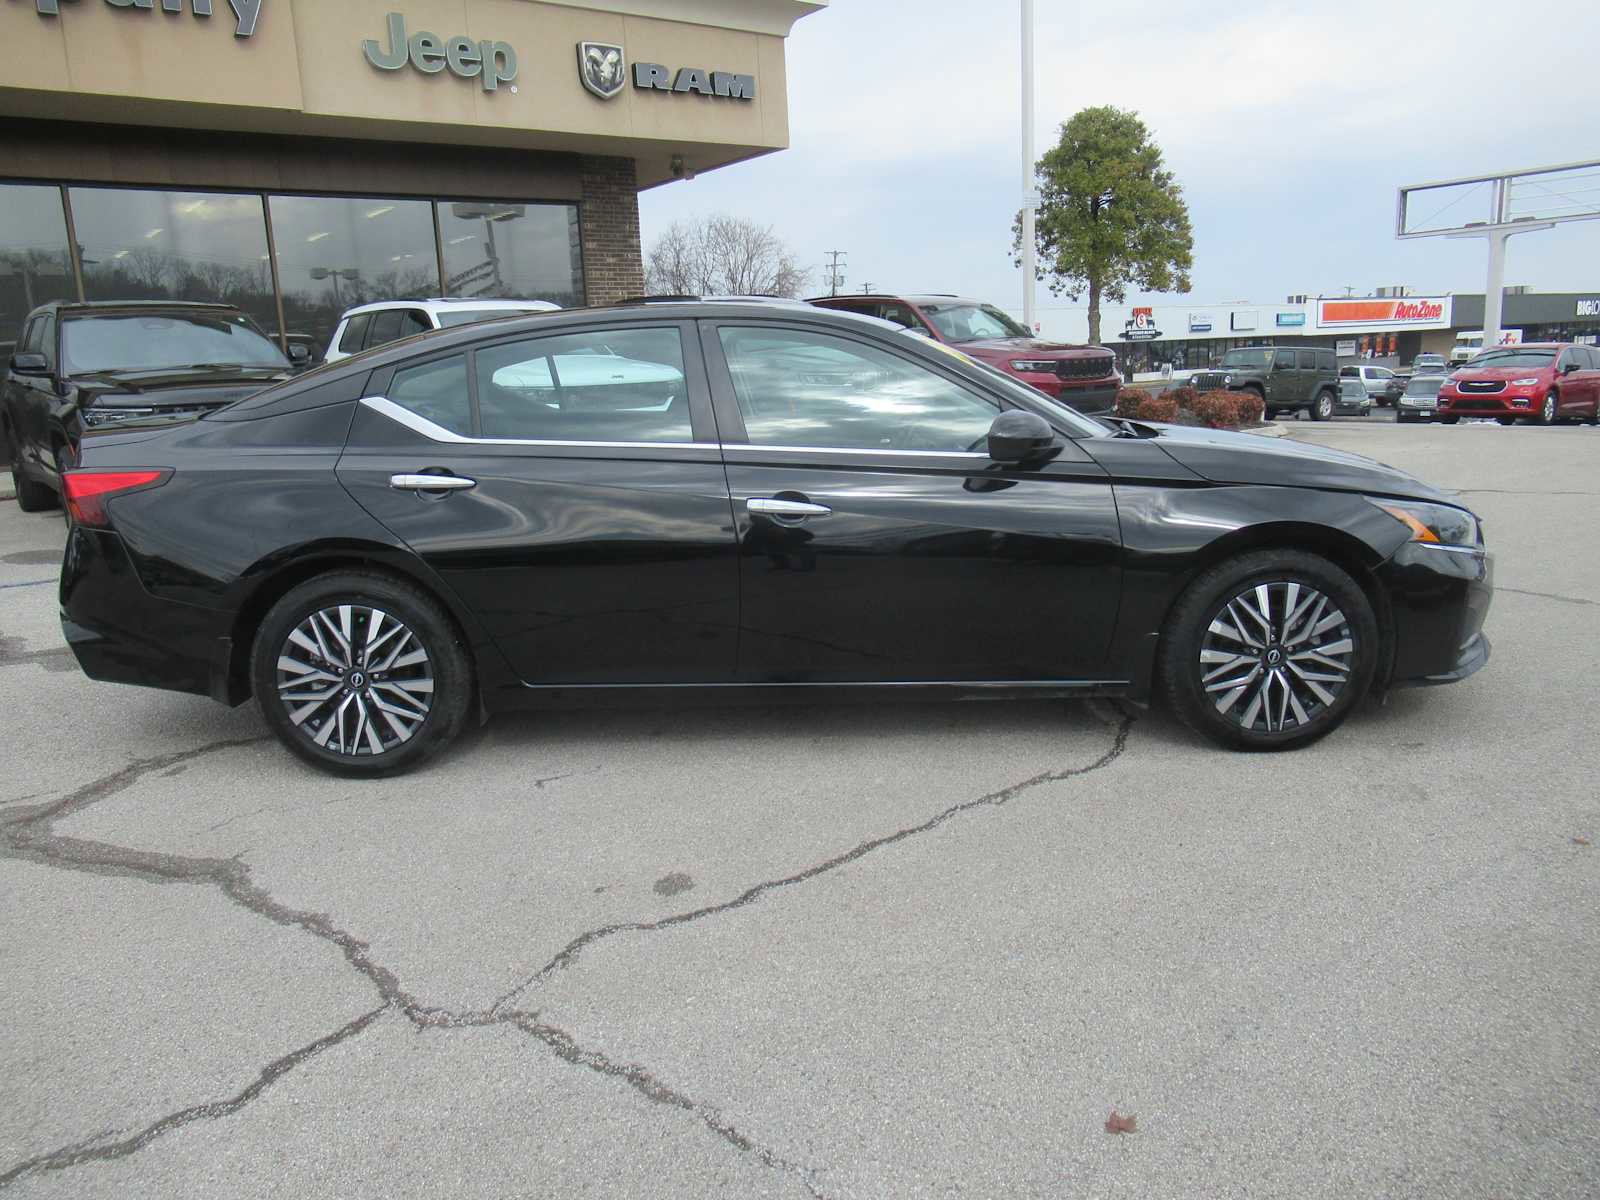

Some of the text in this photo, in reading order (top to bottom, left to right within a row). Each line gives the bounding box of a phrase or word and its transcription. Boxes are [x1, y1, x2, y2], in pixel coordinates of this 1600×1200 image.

[363, 12, 518, 93] Jeep
[632, 62, 756, 100] RAM
[1394, 301, 1442, 319] AutoZone
[1576, 300, 1591, 315] BIG
